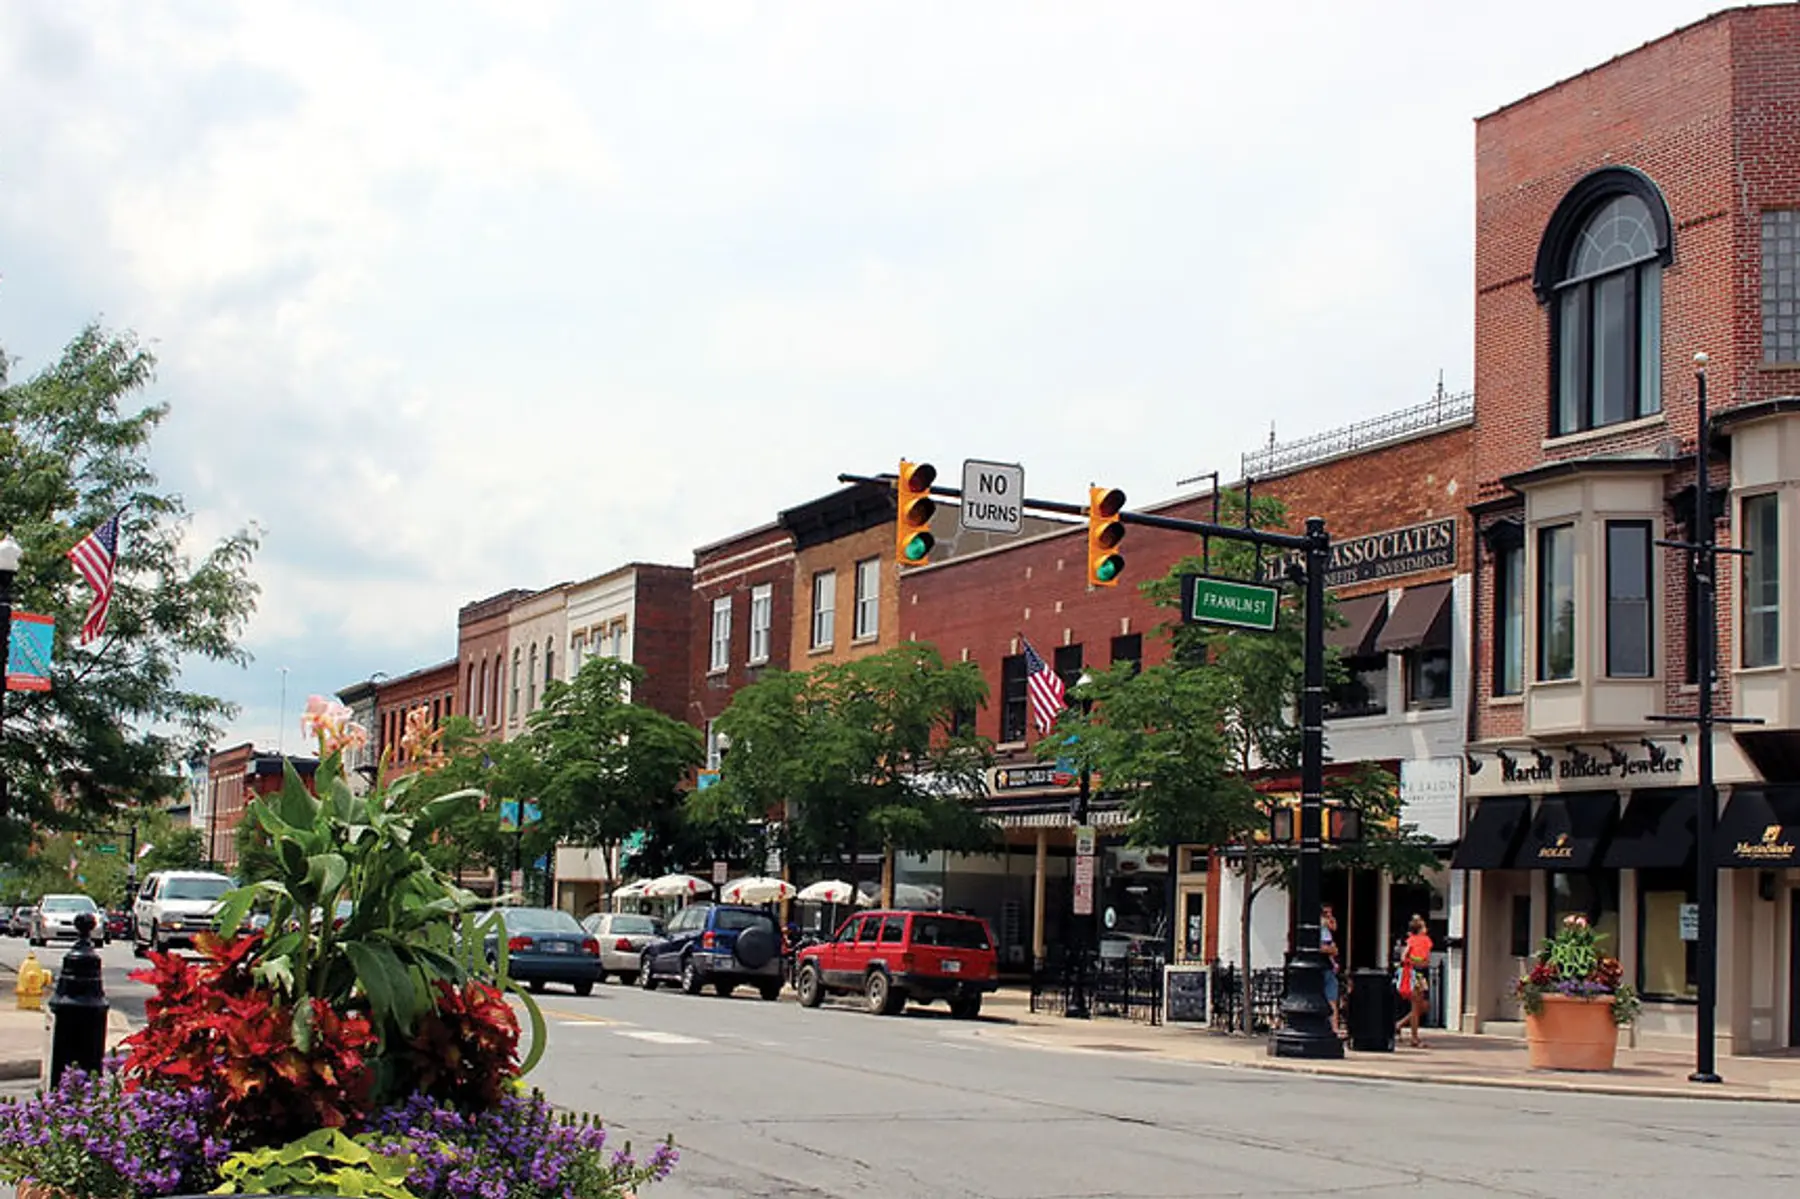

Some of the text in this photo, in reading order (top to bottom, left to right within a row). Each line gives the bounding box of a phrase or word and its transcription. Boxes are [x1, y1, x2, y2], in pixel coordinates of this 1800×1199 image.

[979, 473, 1007, 495] NO
[967, 501, 1018, 523] TURNS
[1328, 521, 1450, 569] ASSOCIATES
[1375, 553, 1448, 577] INVESTMENTS
[1203, 592, 1266, 615] FRANKLIN ST
